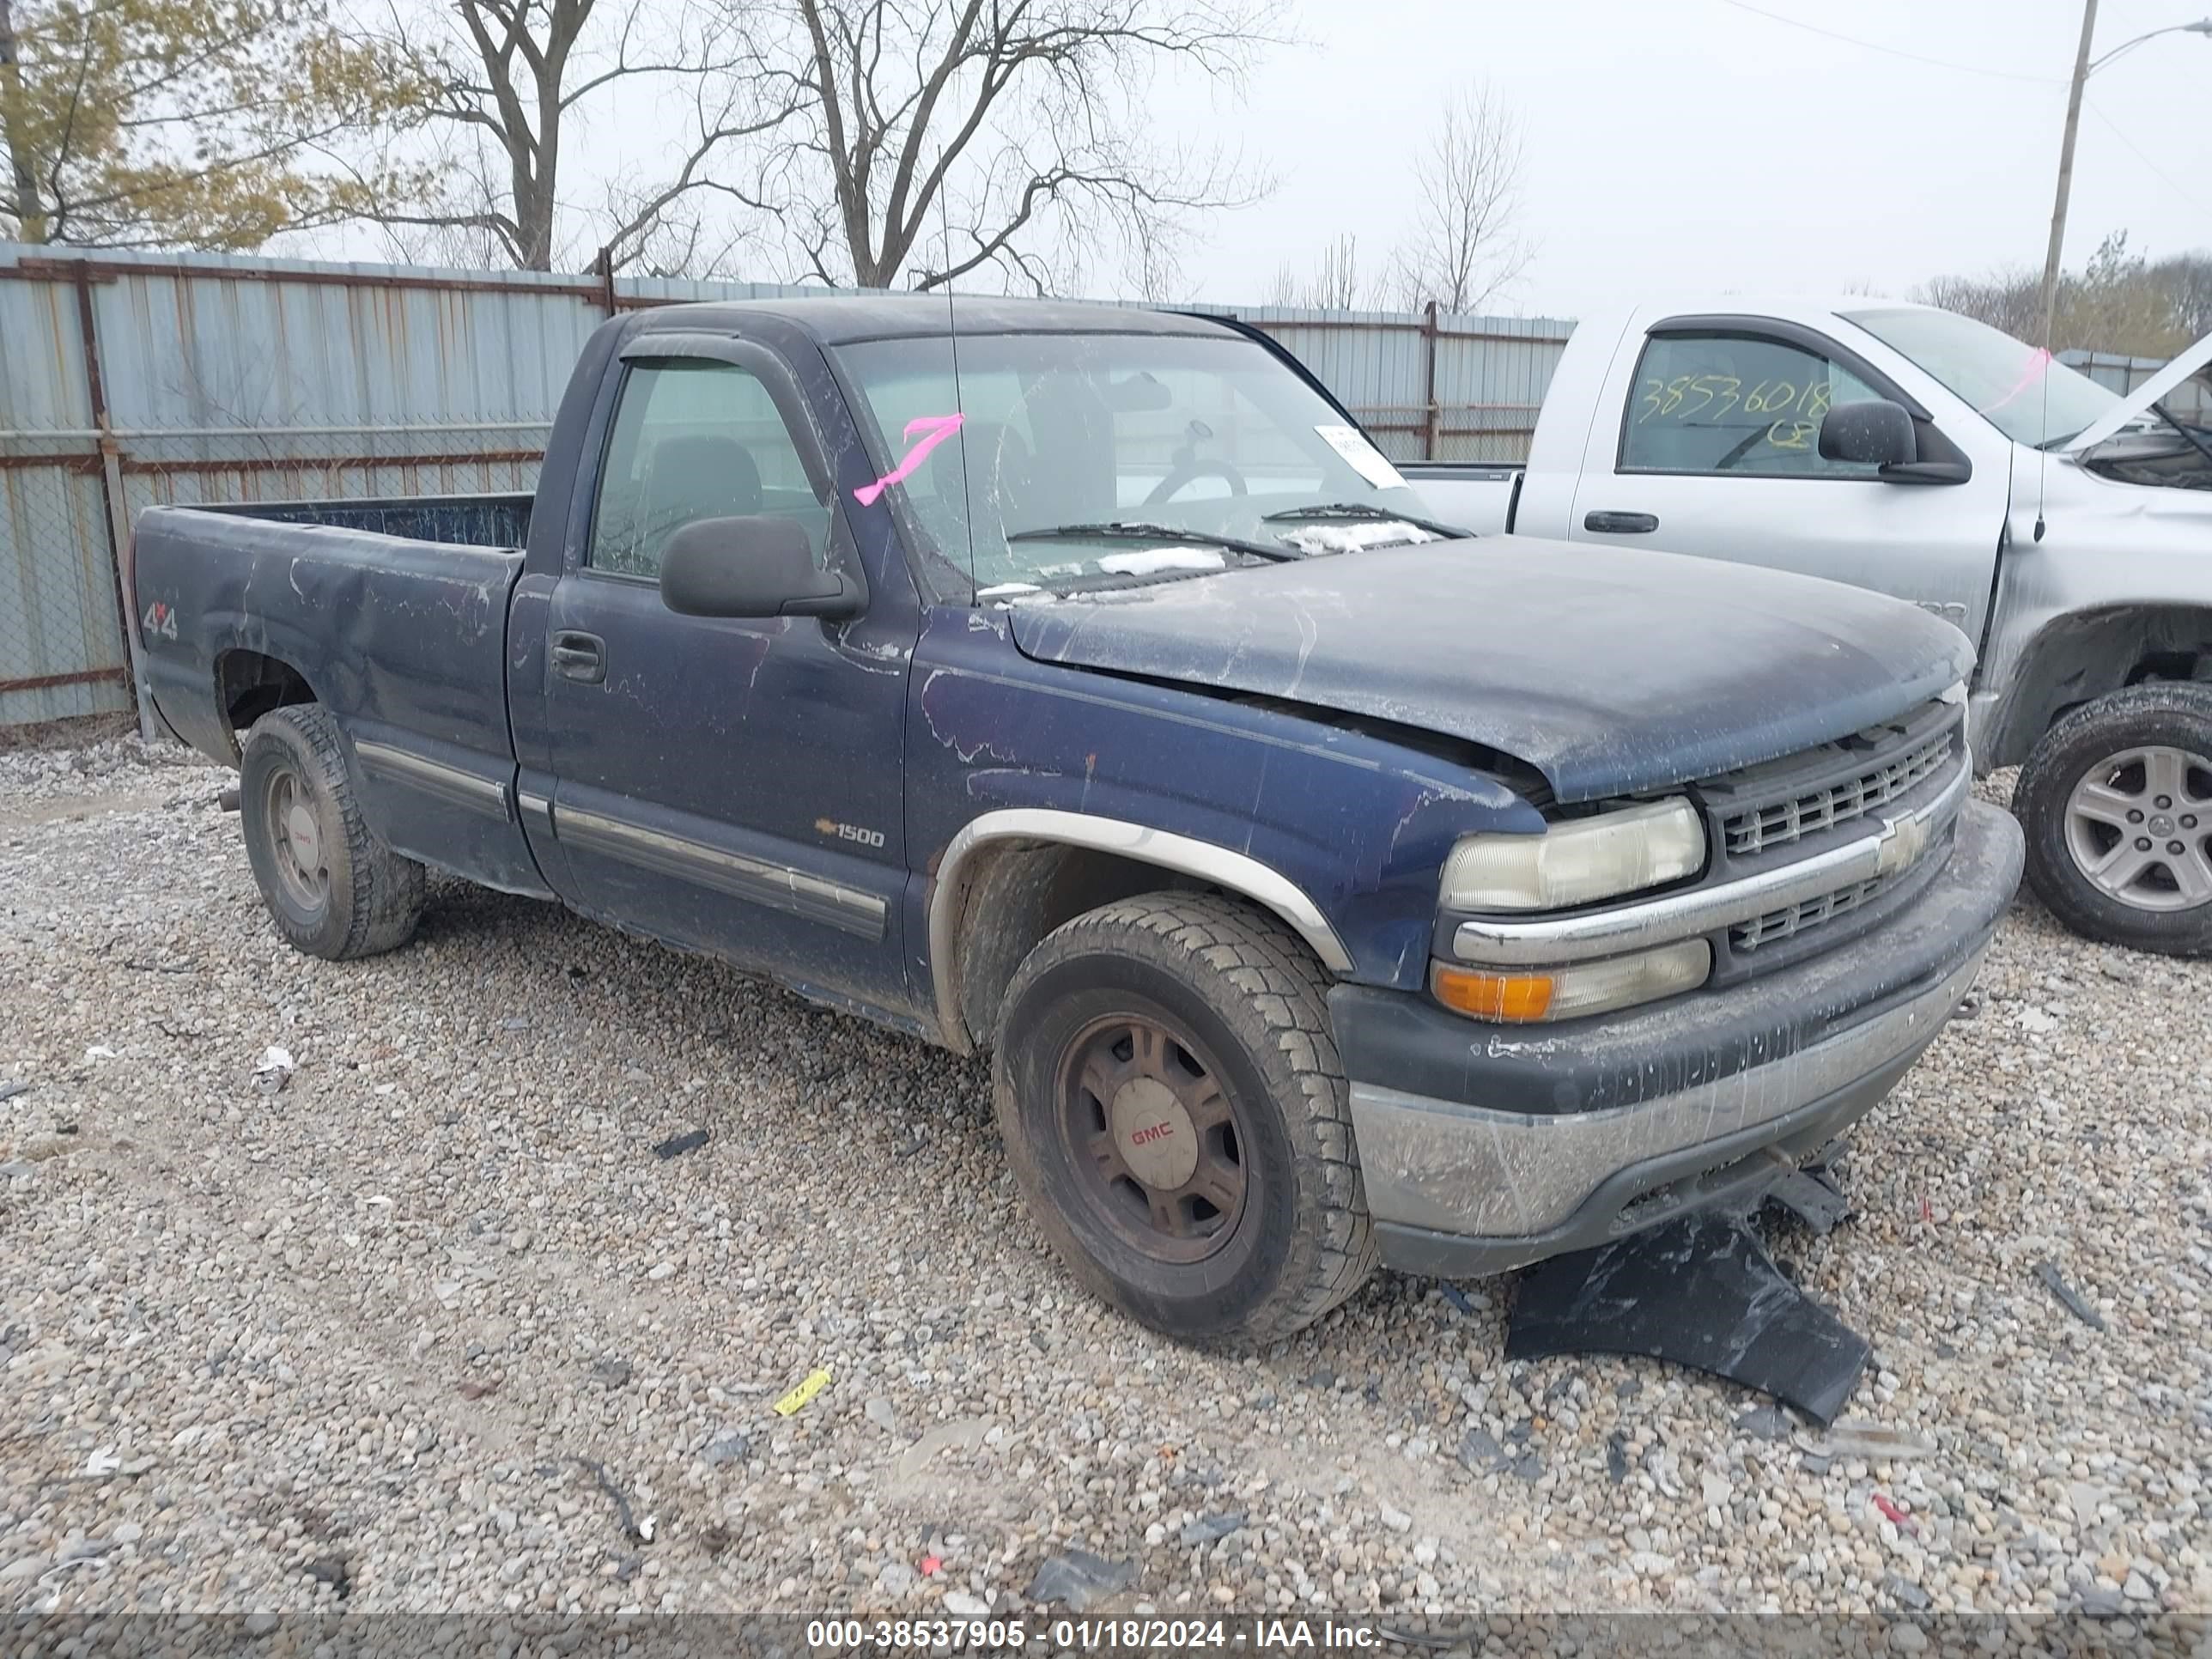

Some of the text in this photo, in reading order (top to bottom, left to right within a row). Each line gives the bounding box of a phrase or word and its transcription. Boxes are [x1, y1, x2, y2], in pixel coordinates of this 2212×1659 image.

[1638, 373, 1831, 424] 38536018
[838, 823, 885, 848] 1500
[1132, 1121, 1174, 1146] GMC
